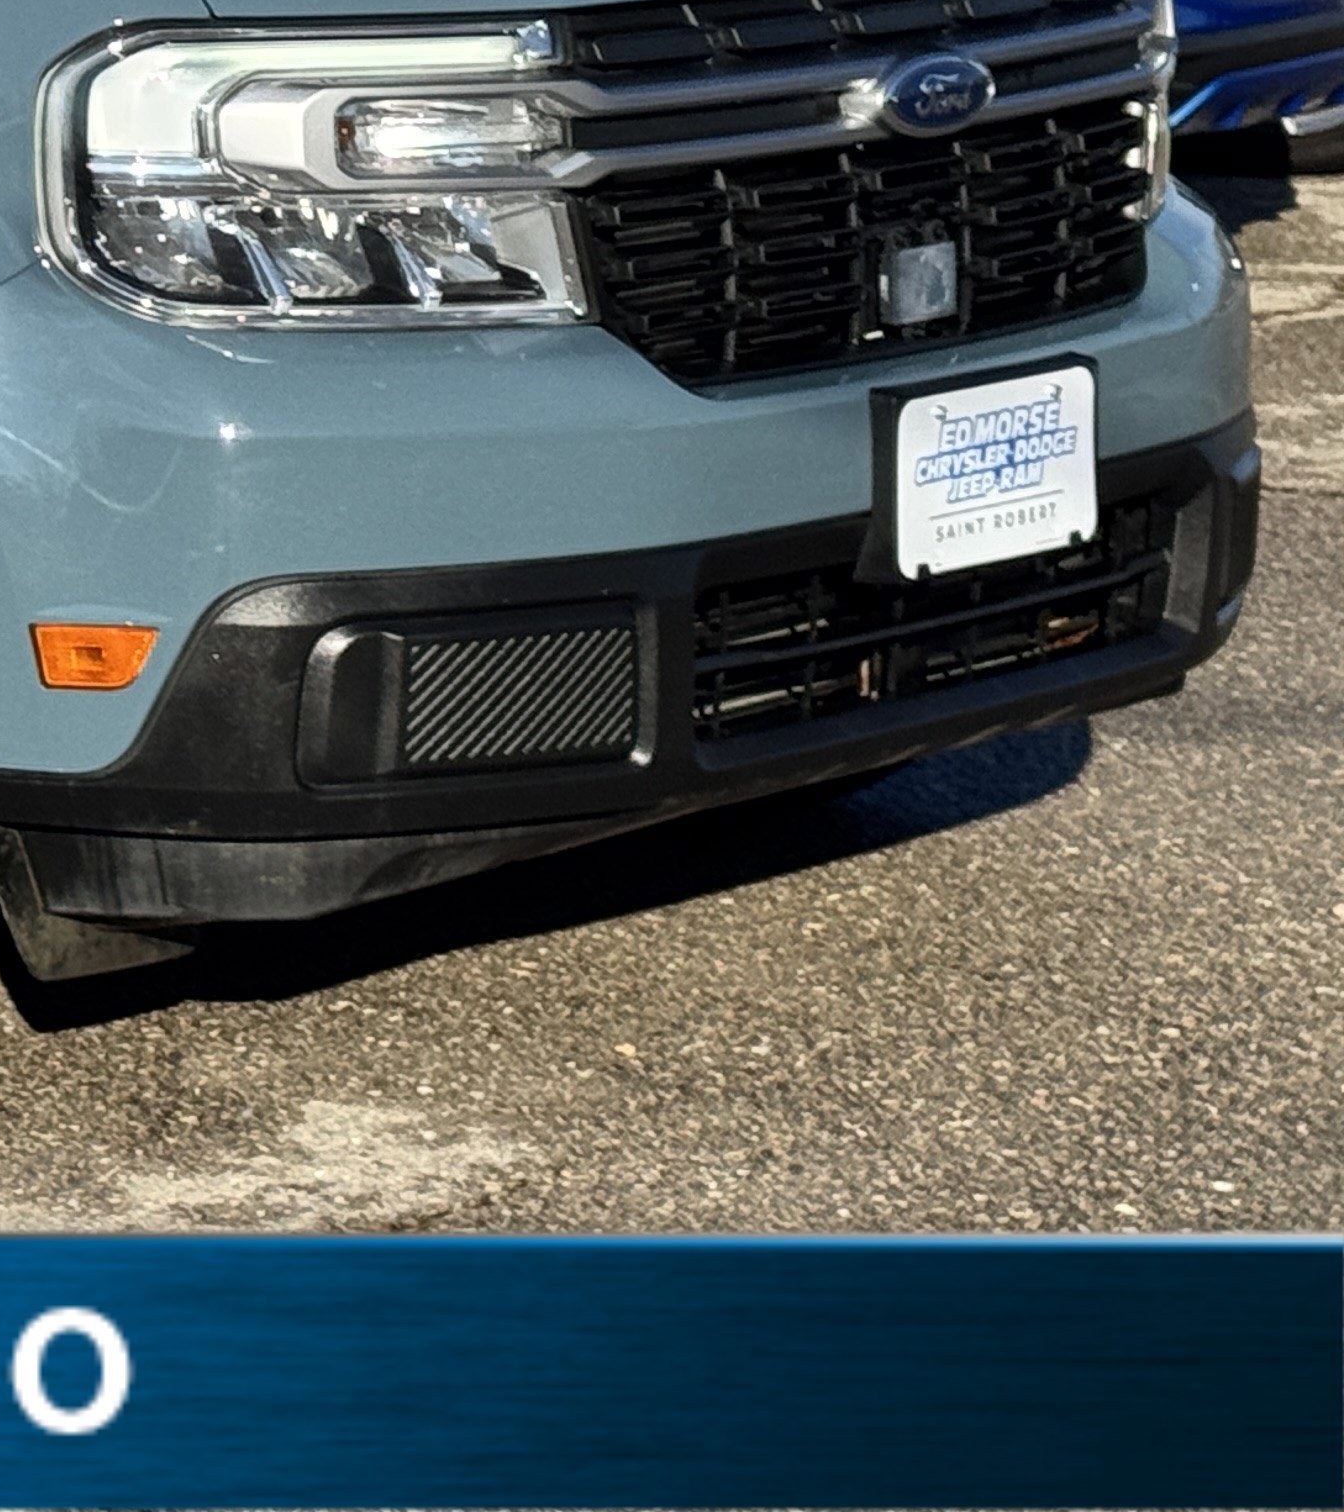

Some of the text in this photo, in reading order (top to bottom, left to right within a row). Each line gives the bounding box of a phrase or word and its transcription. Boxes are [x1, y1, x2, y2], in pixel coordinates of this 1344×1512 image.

[915, 73, 971, 116] Ford
[939, 400, 1062, 455] ED MORSE
[936, 502, 1058, 543] SAINT ROBERT
